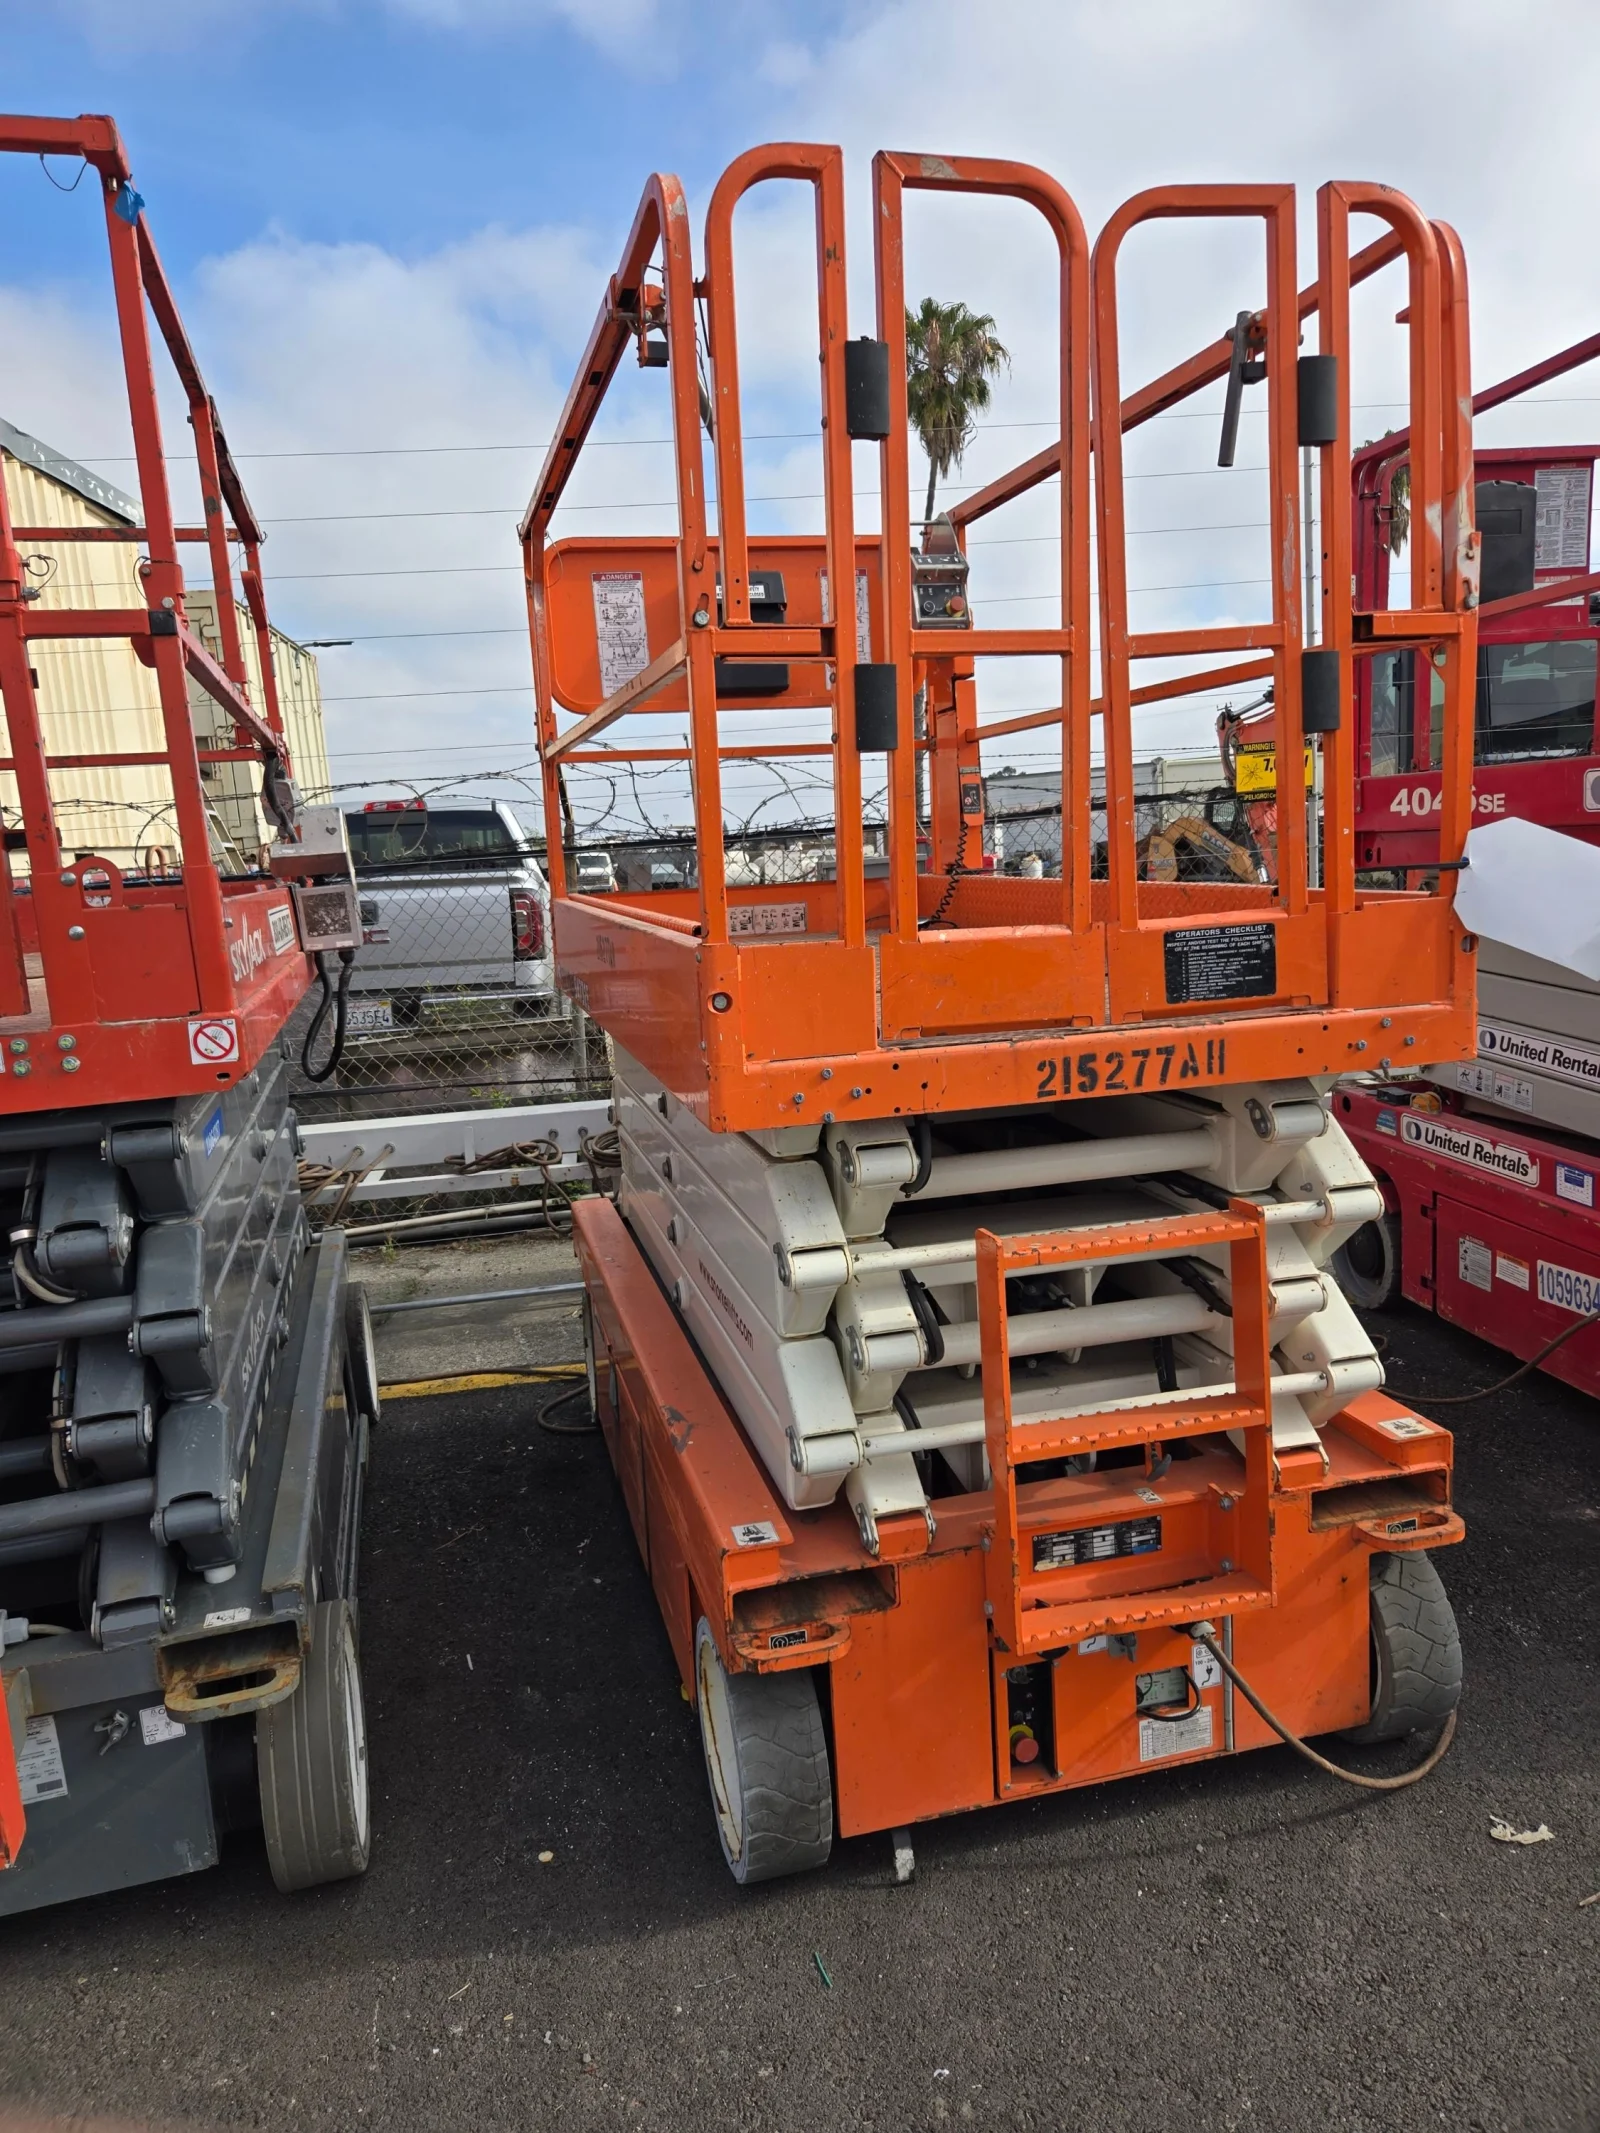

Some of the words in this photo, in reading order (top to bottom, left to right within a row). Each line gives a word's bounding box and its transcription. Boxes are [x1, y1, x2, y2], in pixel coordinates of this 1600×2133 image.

[230, 912, 266, 982] SKYJACK
[1175, 928, 1220, 938] OPERATORS
[1225, 924, 1267, 934] CHECKLIST
[1499, 1035, 1549, 1063] United
[1551, 1049, 1600, 1078] Rental
[1424, 1127, 1469, 1157] United
[1473, 1143, 1530, 1177] Rentals
